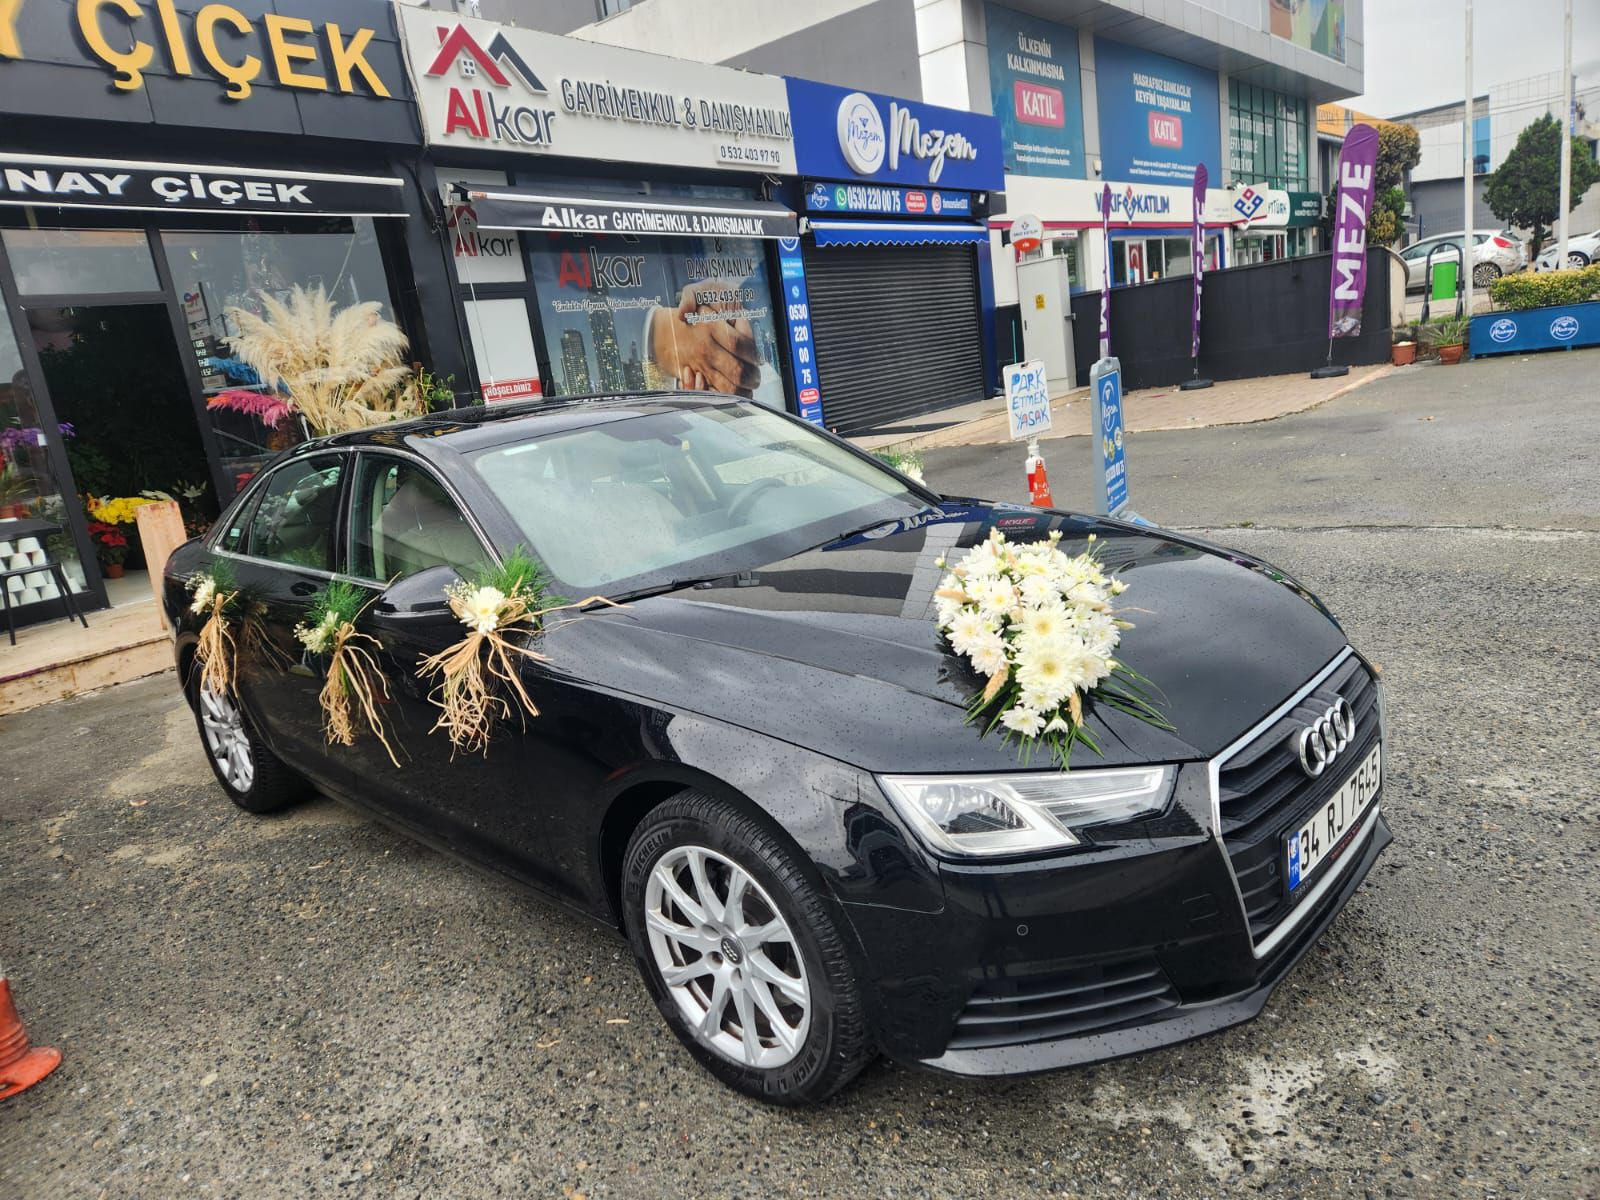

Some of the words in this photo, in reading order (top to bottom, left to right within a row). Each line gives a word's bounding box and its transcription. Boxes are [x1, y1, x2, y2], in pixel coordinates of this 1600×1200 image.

[76, 0, 392, 99] ÇİÇEK
[1018, 32, 1052, 58] ÜLKENİN
[1007, 53, 1065, 80] KALKINMASINA
[445, 87, 556, 145] Alkar
[561, 78, 682, 125] GAYRİMENKUL
[684, 97, 697, 127] &
[700, 100, 794, 141] DANIŞMANLIK
[1022, 89, 1057, 120] KATIL
[847, 117, 883, 151] Mezem
[888, 101, 978, 184] Mezem
[1153, 119, 1178, 142] KATIL
[720, 145, 727, 158] 0
[727, 146, 743, 160] 532
[745, 147, 759, 161] 403
[760, 149, 769, 163] 97
[770, 150, 781, 163] 90
[0, 168, 131, 196] NAY
[151, 173, 313, 205] ÇİÇEK
[847, 185, 867, 209] 0530
[867, 187, 882, 210] 220
[882, 189, 892, 212] 00
[892, 190, 901, 212] 75
[1136, 194, 1170, 214] KATILIM
[541, 206, 608, 230] Alkar
[612, 209, 692, 232] GAYRİMENKUL
[692, 215, 701, 233] &
[702, 215, 765, 236] DANIŞMANLIK
[1334, 161, 1372, 301] MEZE
[454, 231, 515, 257] Alkar
[558, 245, 647, 289] Alkar
[686, 257, 756, 283] DANIŞMANLIK
[703, 289, 718, 304] 532
[719, 288, 734, 303] 403
[788, 303, 808, 321] 0530
[793, 325, 809, 342] 220
[798, 346, 810, 364] 00
[801, 368, 812, 384] 75
[1011, 367, 1045, 395] PARK
[1012, 388, 1048, 411] ETMEK
[1014, 404, 1050, 431] YASAK
[1300, 821, 1320, 871] 34
[1327, 791, 1345, 844] RJ
[1350, 751, 1378, 817] 7645
